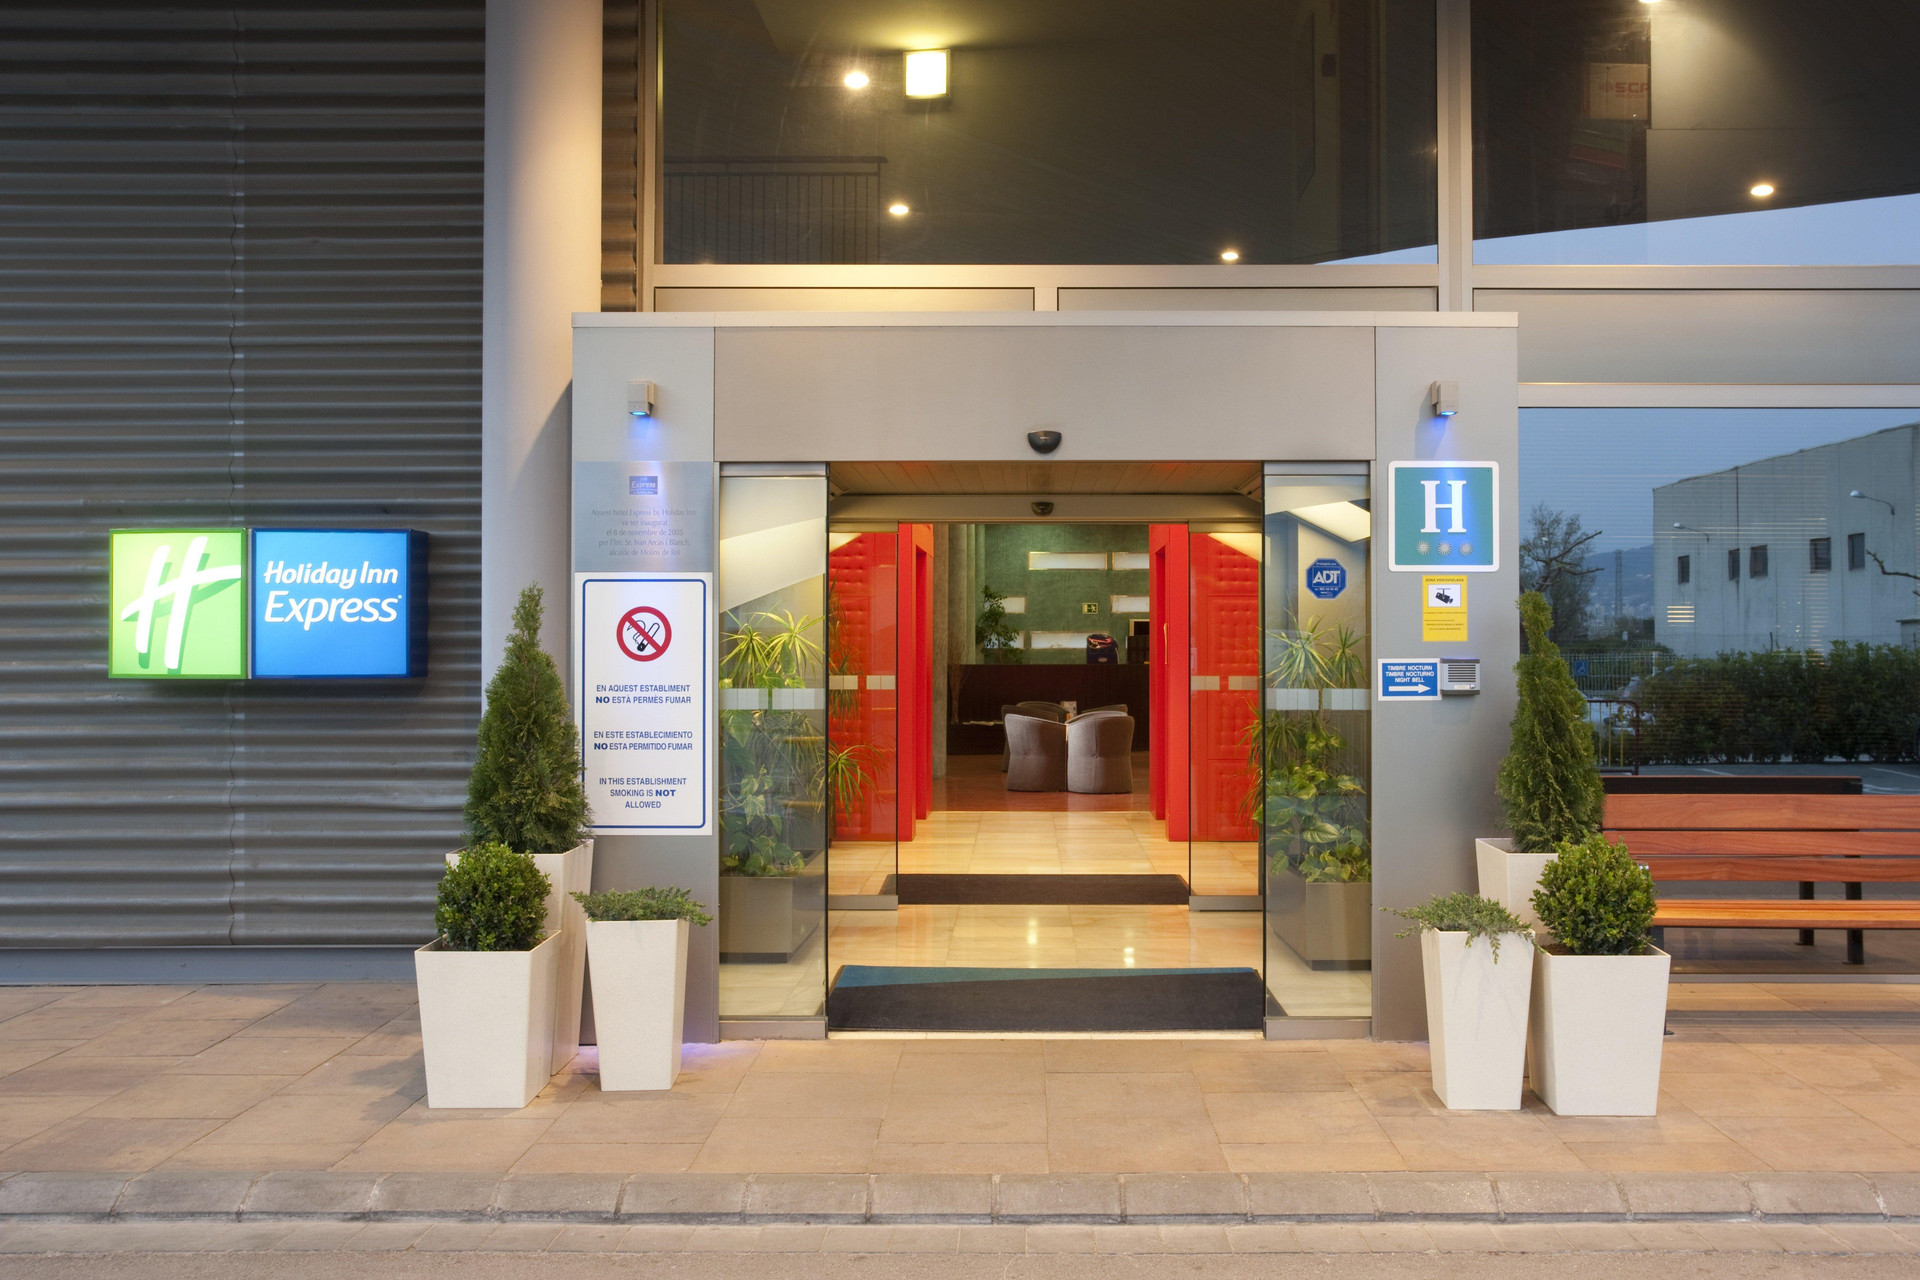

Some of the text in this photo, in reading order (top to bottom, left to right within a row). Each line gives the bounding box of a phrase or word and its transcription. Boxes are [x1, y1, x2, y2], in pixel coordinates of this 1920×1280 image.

[631, 480, 656, 489] Express
[1420, 480, 1467, 533] H
[612, 508, 628, 517] hotel
[629, 508, 652, 518] Express
[653, 508, 660, 518] by
[662, 508, 685, 518] Holiday
[686, 508, 697, 517] Inn
[640, 519, 668, 528] inaugurat
[598, 540, 608, 548] per
[648, 538, 664, 546] Arcas
[609, 548, 630, 556] alcalde
[631, 548, 639, 556] de
[640, 548, 660, 556] Molins
[661, 548, 669, 556] de
[263, 560, 399, 590] Holiday Inn
[1312, 570, 1341, 584] ADT
[263, 590, 400, 631] Express
[595, 694, 691, 704] NO ESTÀ PERMÈS FUMAR
[593, 731, 693, 739] EN ESTE ESTABLECIMIENTO
[610, 789, 676, 797] SMOKING IS NOT
